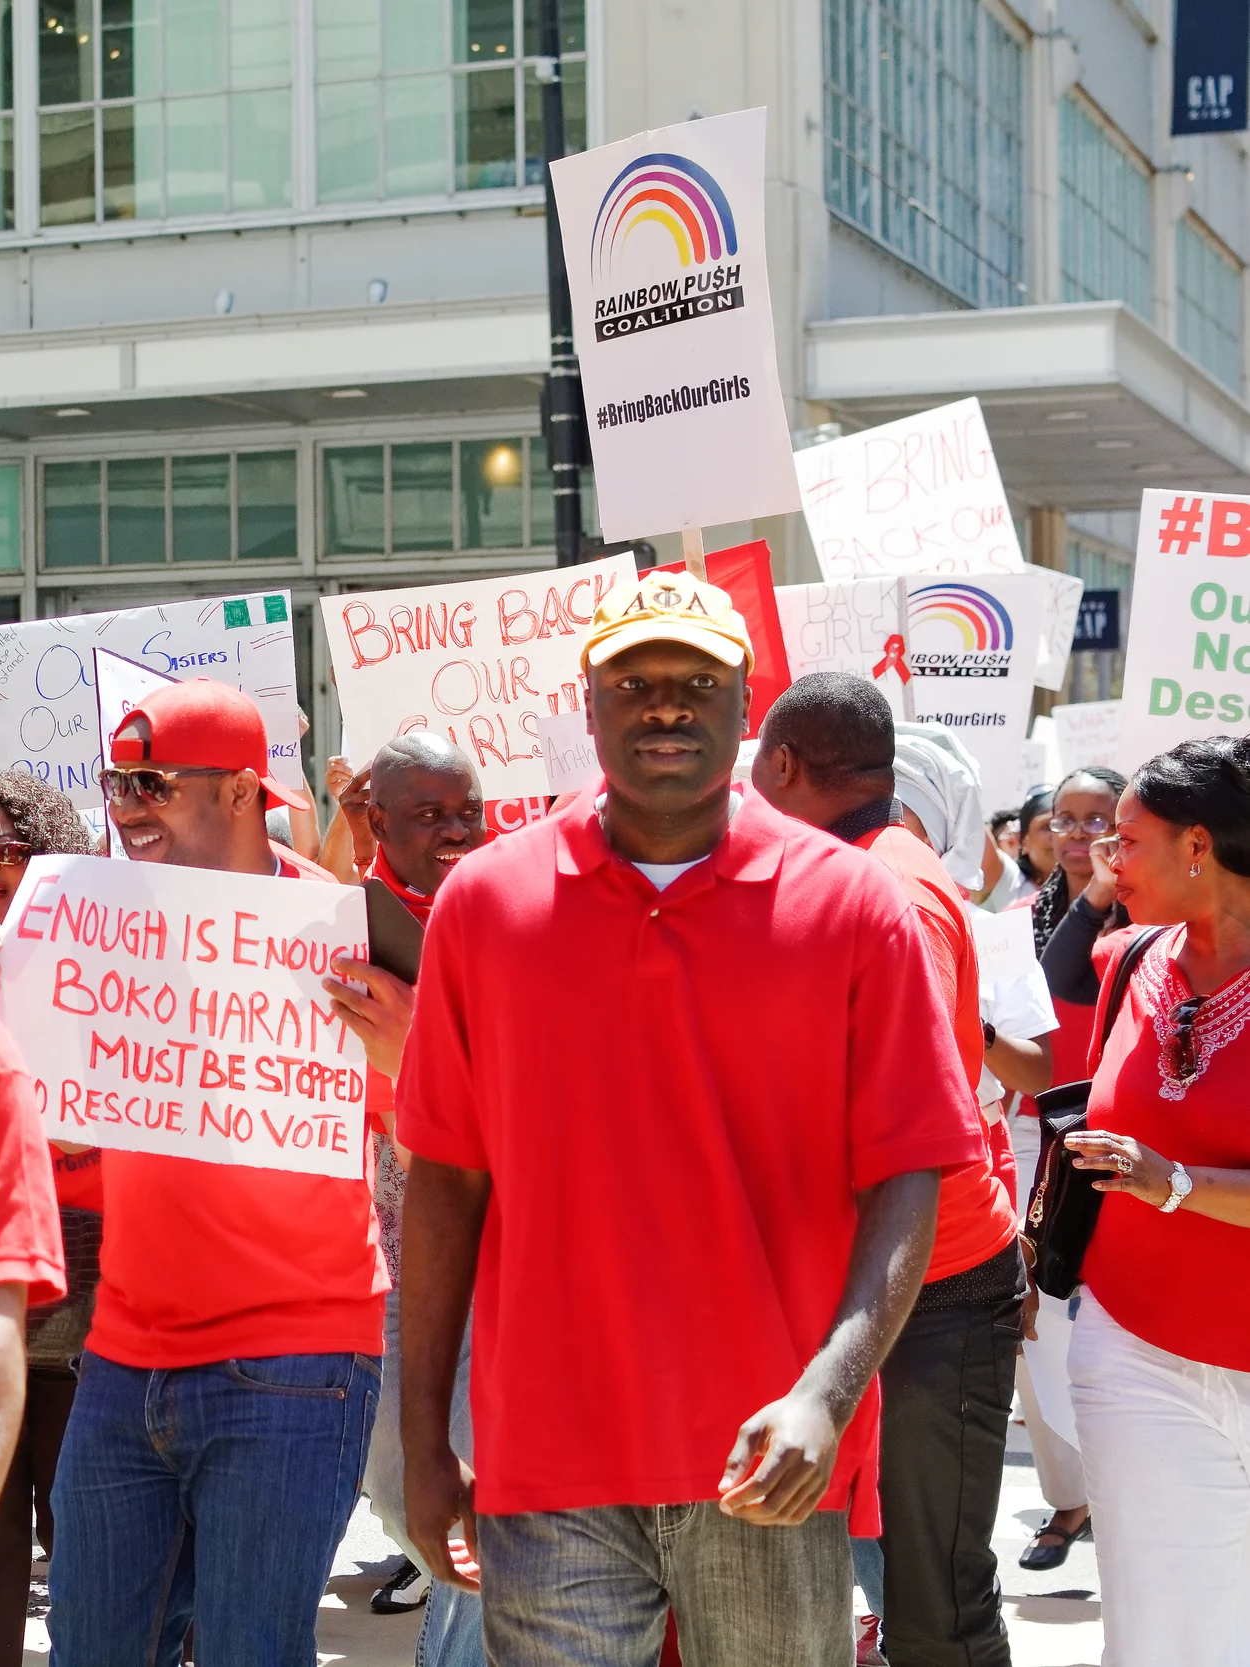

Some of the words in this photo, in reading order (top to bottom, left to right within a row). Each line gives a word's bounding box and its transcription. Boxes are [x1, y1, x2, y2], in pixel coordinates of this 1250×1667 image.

[594, 278, 678, 319] RAINBOW
[601, 292, 733, 338] COALITION
[597, 375, 751, 430] #BringBackOurGirls
[865, 413, 993, 514] BRING
[821, 523, 945, 578] BACK
[806, 579, 898, 623] BACK
[343, 600, 478, 670] BRING
[431, 656, 540, 716] OUR
[912, 667, 1000, 677] ALITION
[1148, 677, 1250, 724] Des
[20, 705, 89, 753] OUR
[546, 736, 597, 779] Anth
[16, 874, 168, 961] ENOUGH
[181, 914, 219, 964] IS
[52, 958, 177, 1025] BOKO
[189, 986, 349, 1055] HARAM
[89, 1031, 198, 1088] MUST
[200, 1048, 246, 1091] BE
[255, 1054, 364, 1103] STOPPED
[199, 1099, 253, 1144] NO
[260, 1109, 350, 1154] VOTE
